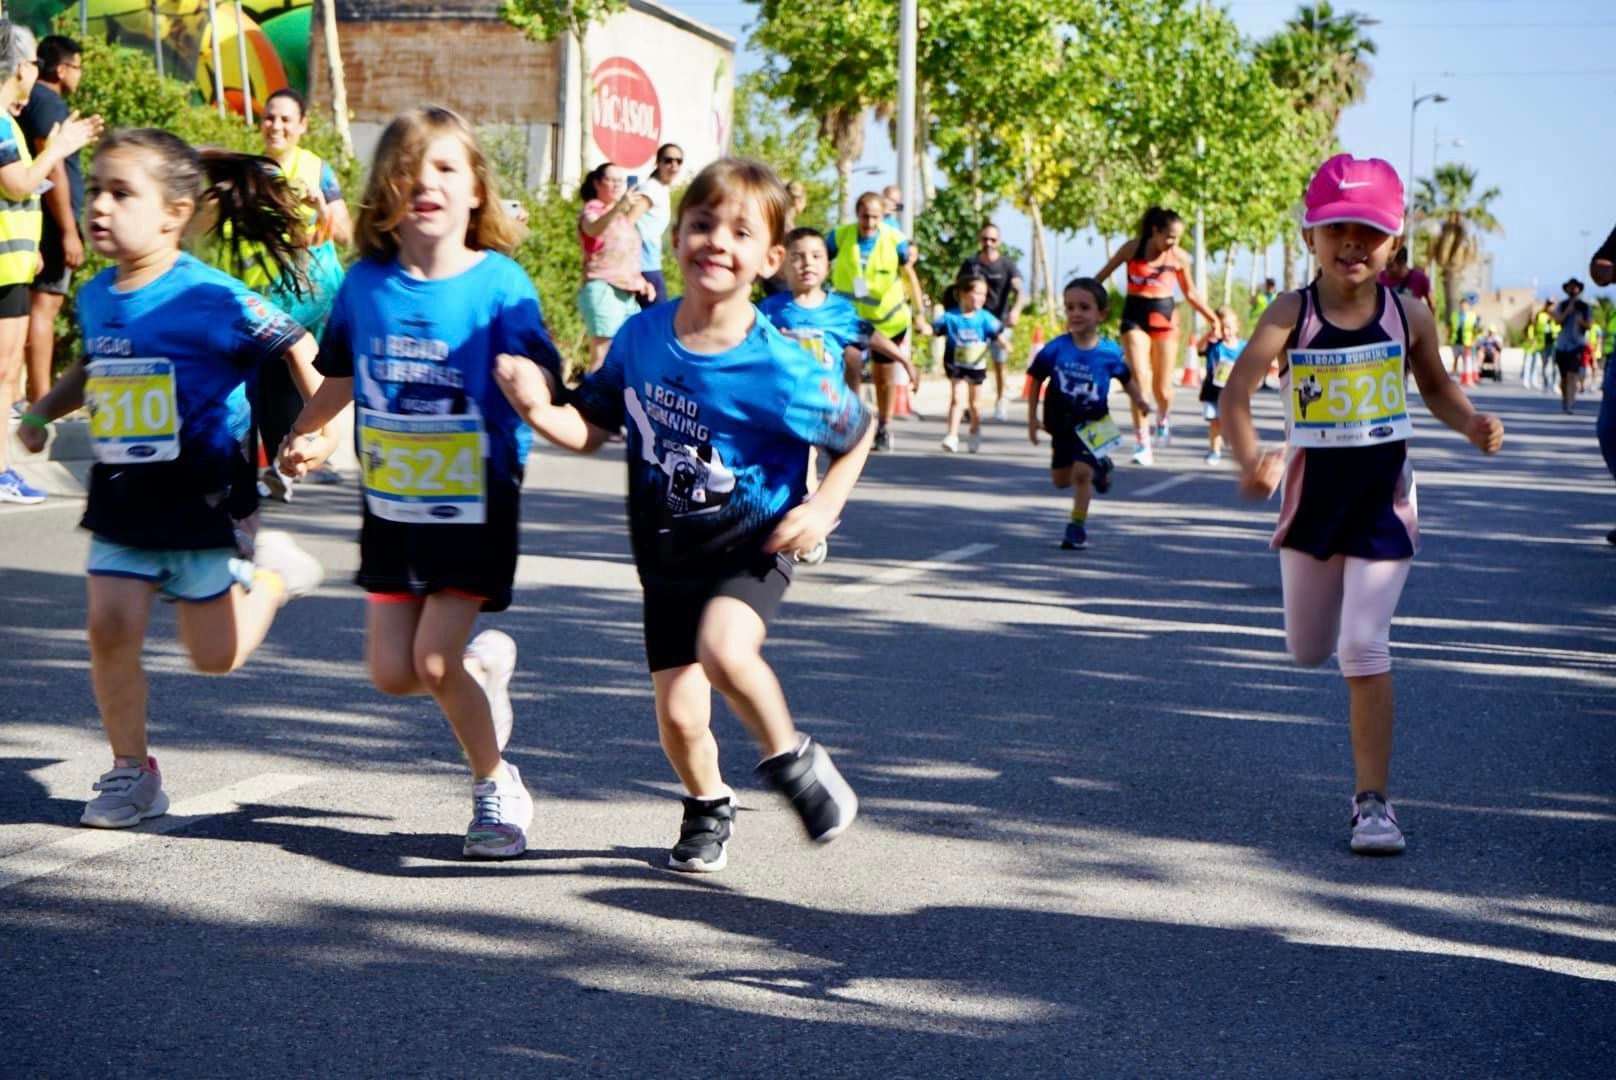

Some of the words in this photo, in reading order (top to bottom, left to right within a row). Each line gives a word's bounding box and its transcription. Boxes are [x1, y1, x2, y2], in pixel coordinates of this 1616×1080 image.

[1315, 353, 1343, 366] ROAD
[1345, 348, 1388, 365] RUNNING
[97, 387, 170, 432] 510
[655, 386, 697, 417] ROAD
[1327, 371, 1401, 417] 526
[387, 447, 480, 490] 524
